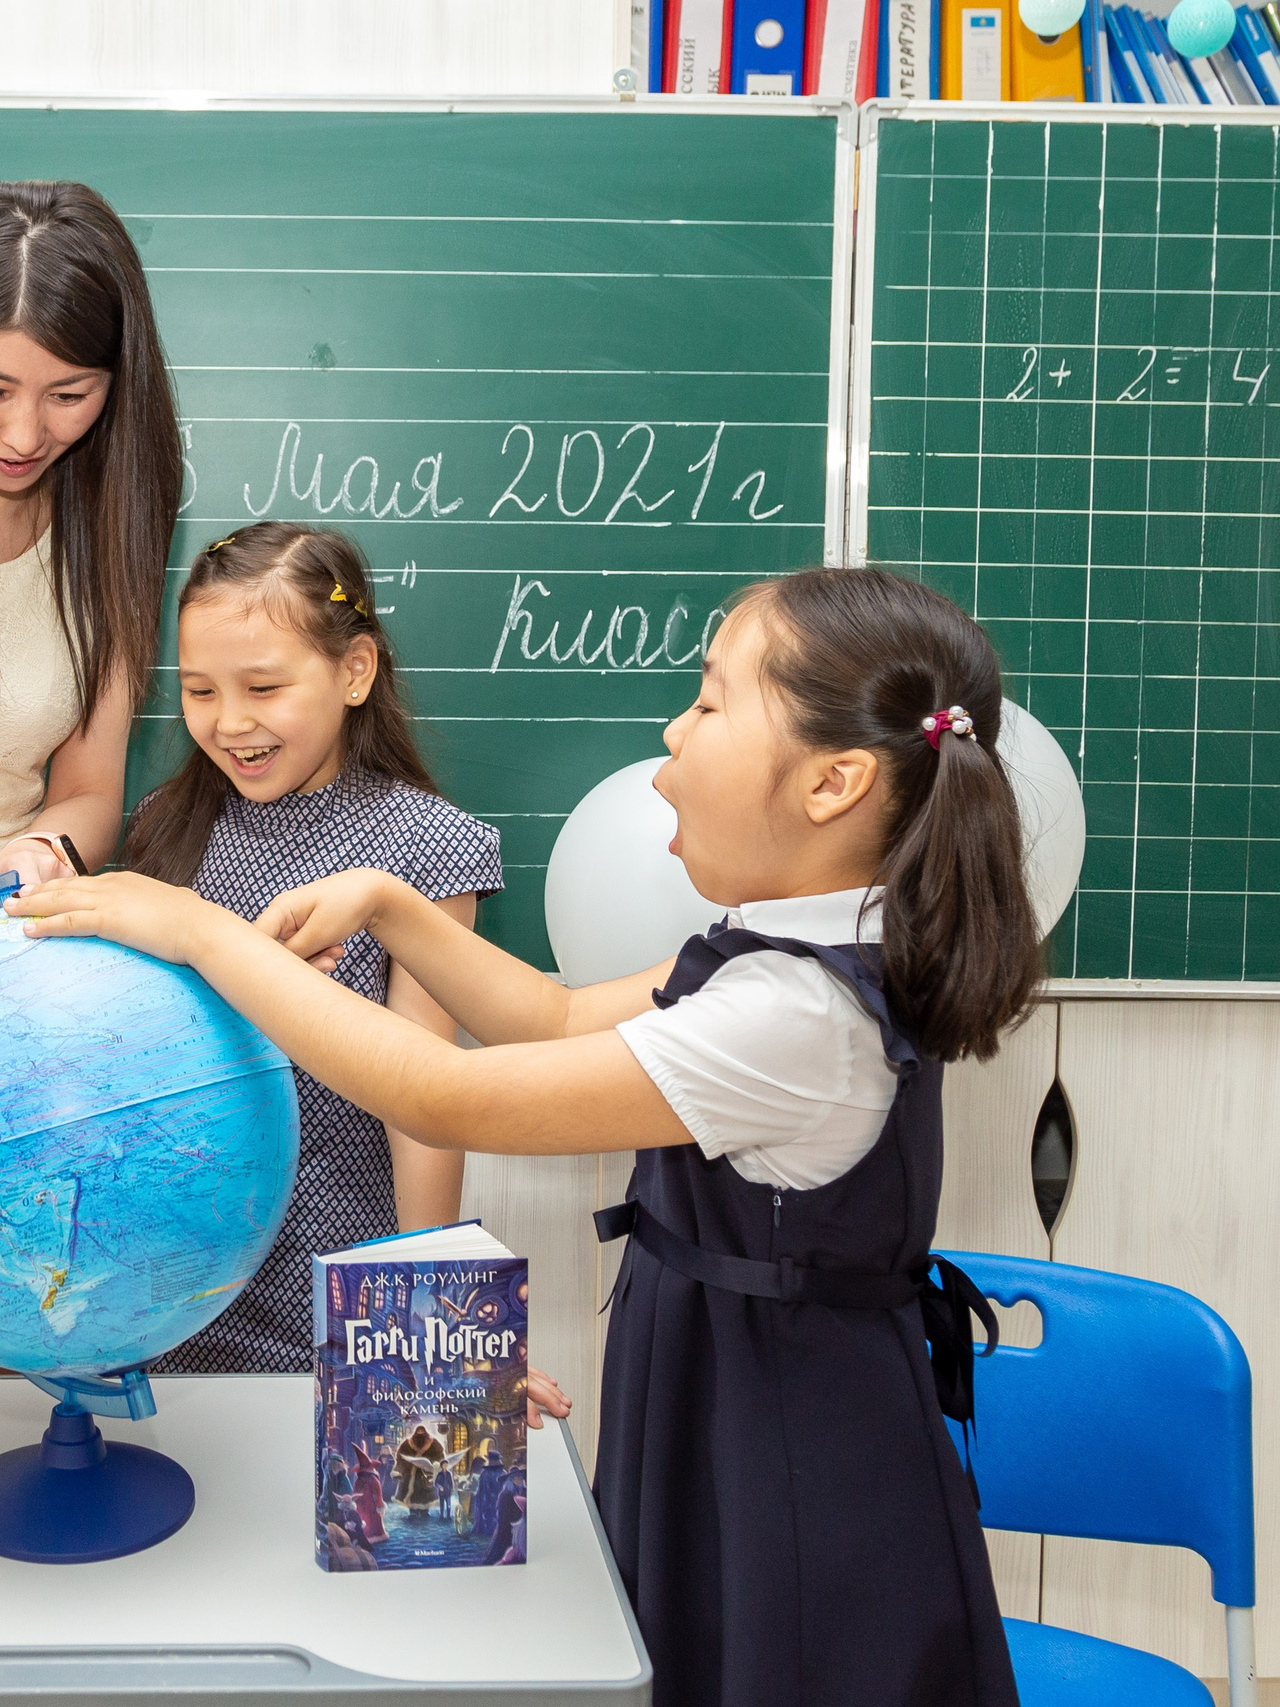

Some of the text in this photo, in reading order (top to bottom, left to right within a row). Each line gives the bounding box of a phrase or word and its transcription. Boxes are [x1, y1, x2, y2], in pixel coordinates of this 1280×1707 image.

[898, 3, 916, 99] ТЕРАТУРА
[679, 38, 696, 95] ССКИЙ
[707, 67, 720, 94] ЫК
[243, 421, 464, 519] Мая
[489, 422, 726, 523] 2021
[413, 1270, 498, 1288] РОУЛИНГ
[372, 1387, 487, 1404] ФИЛОСОФСКИЙ
[400, 1403, 460, 1416] КАМЕНЬ
